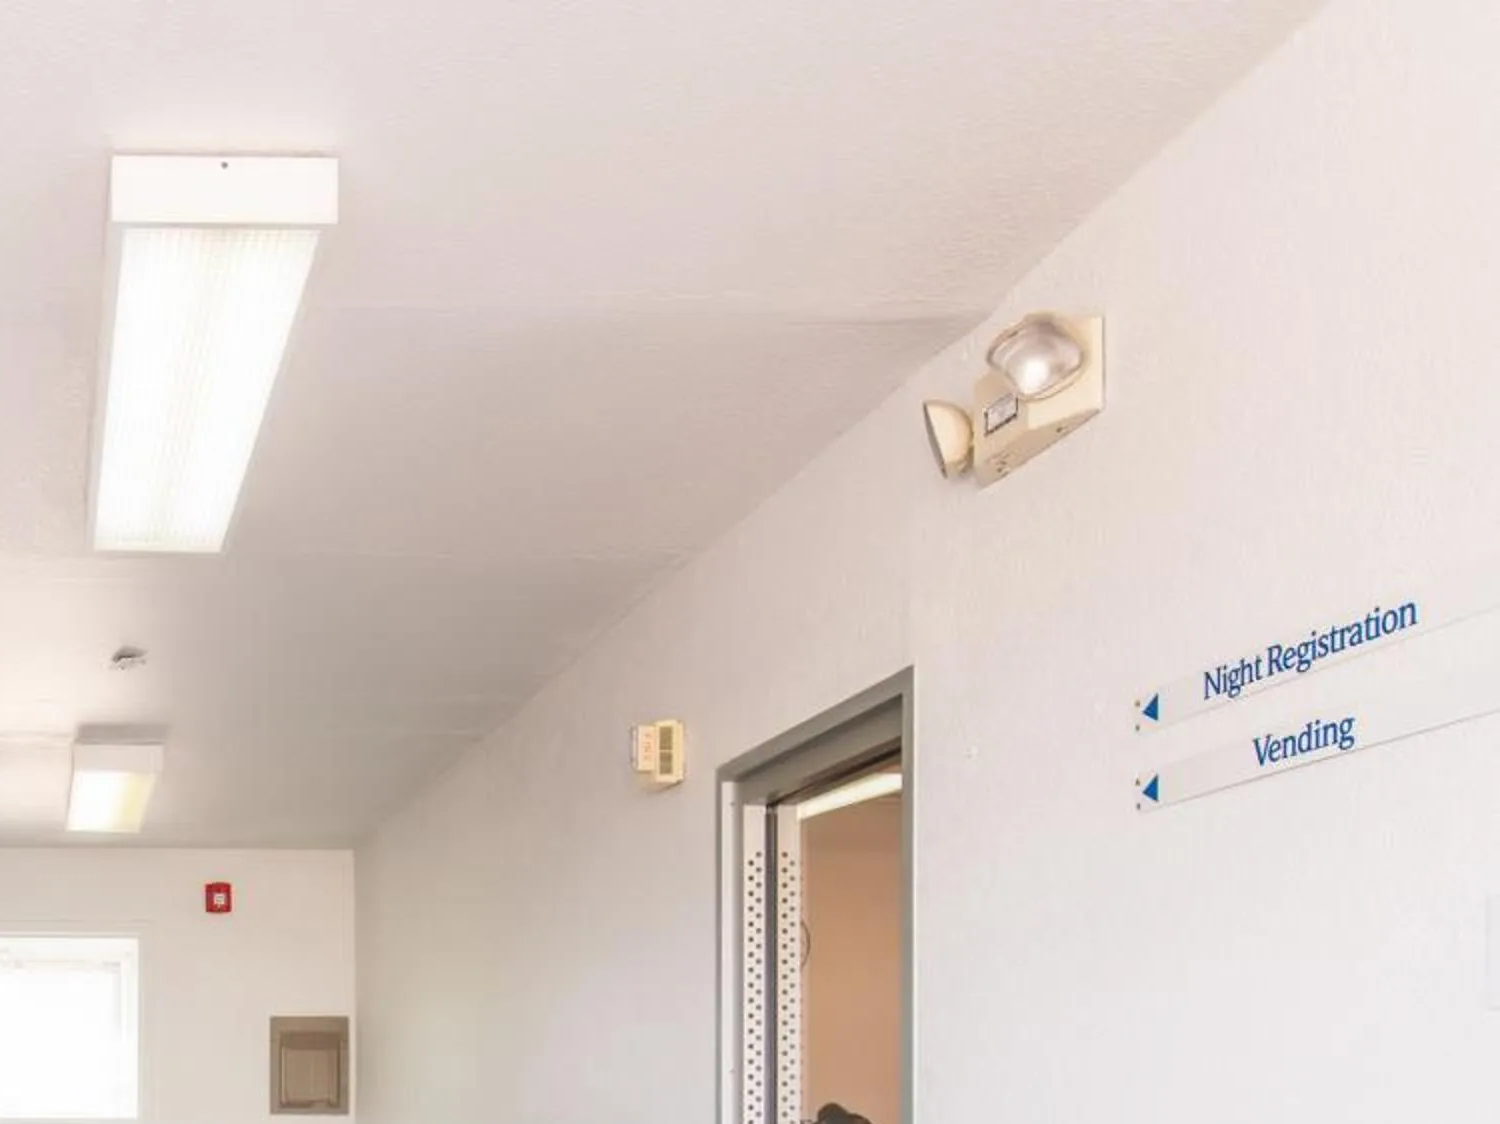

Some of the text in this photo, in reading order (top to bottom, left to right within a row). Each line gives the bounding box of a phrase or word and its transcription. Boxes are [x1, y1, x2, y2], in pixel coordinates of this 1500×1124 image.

[1203, 602, 1417, 700] Night Registration
[1253, 716, 1356, 766] Vending
